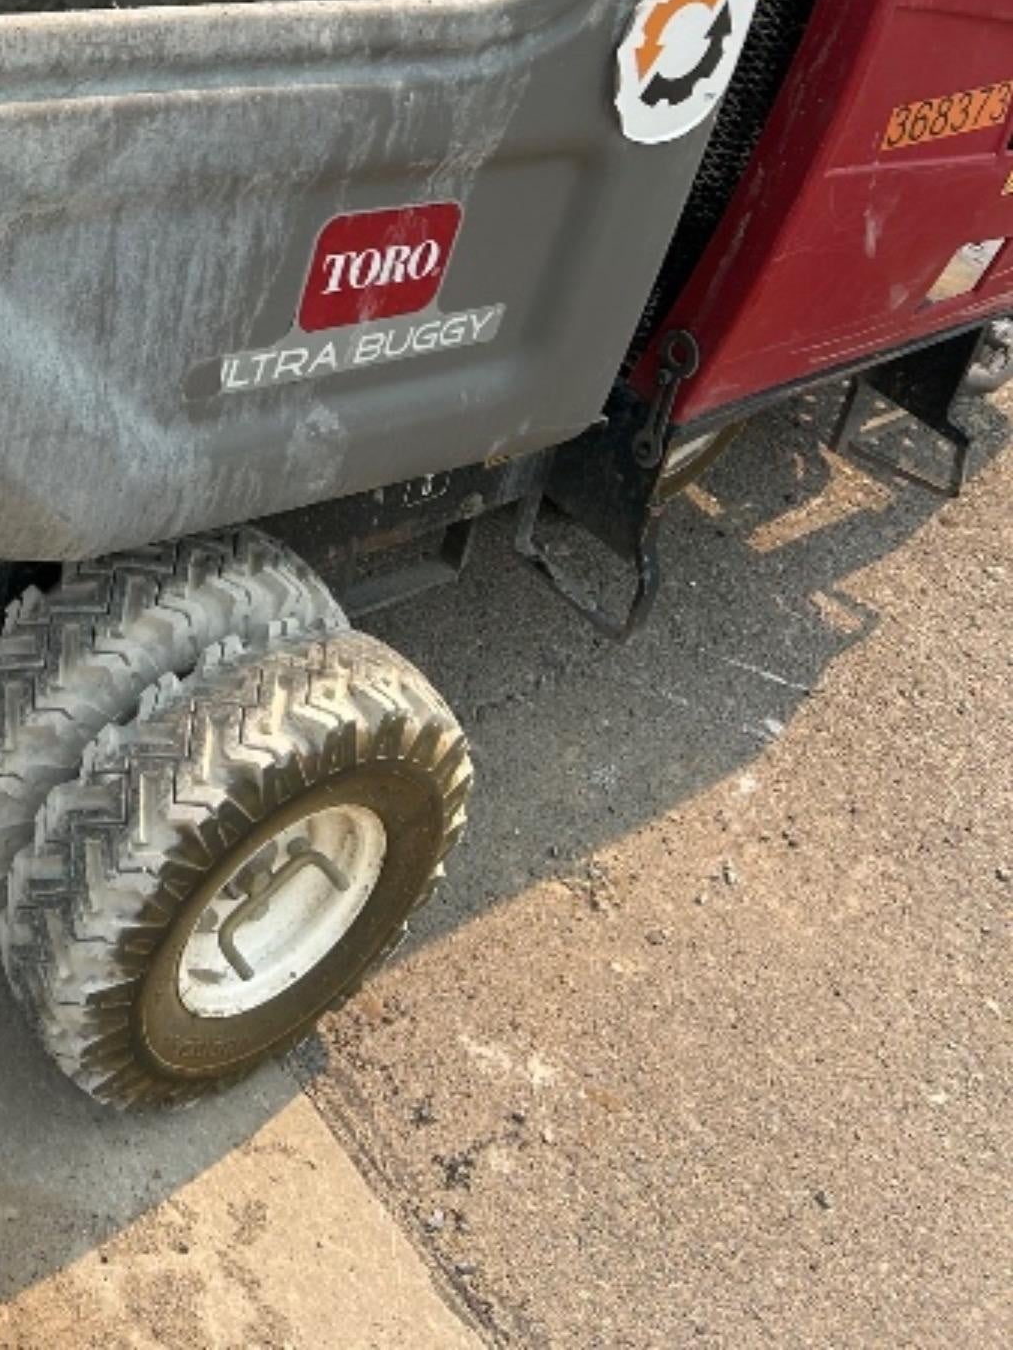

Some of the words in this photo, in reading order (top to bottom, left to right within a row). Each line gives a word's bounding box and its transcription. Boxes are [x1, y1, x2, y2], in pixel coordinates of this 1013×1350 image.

[886, 81, 1010, 147] 368373
[321, 238, 440, 296] TORO
[352, 310, 494, 364] BUGGY
